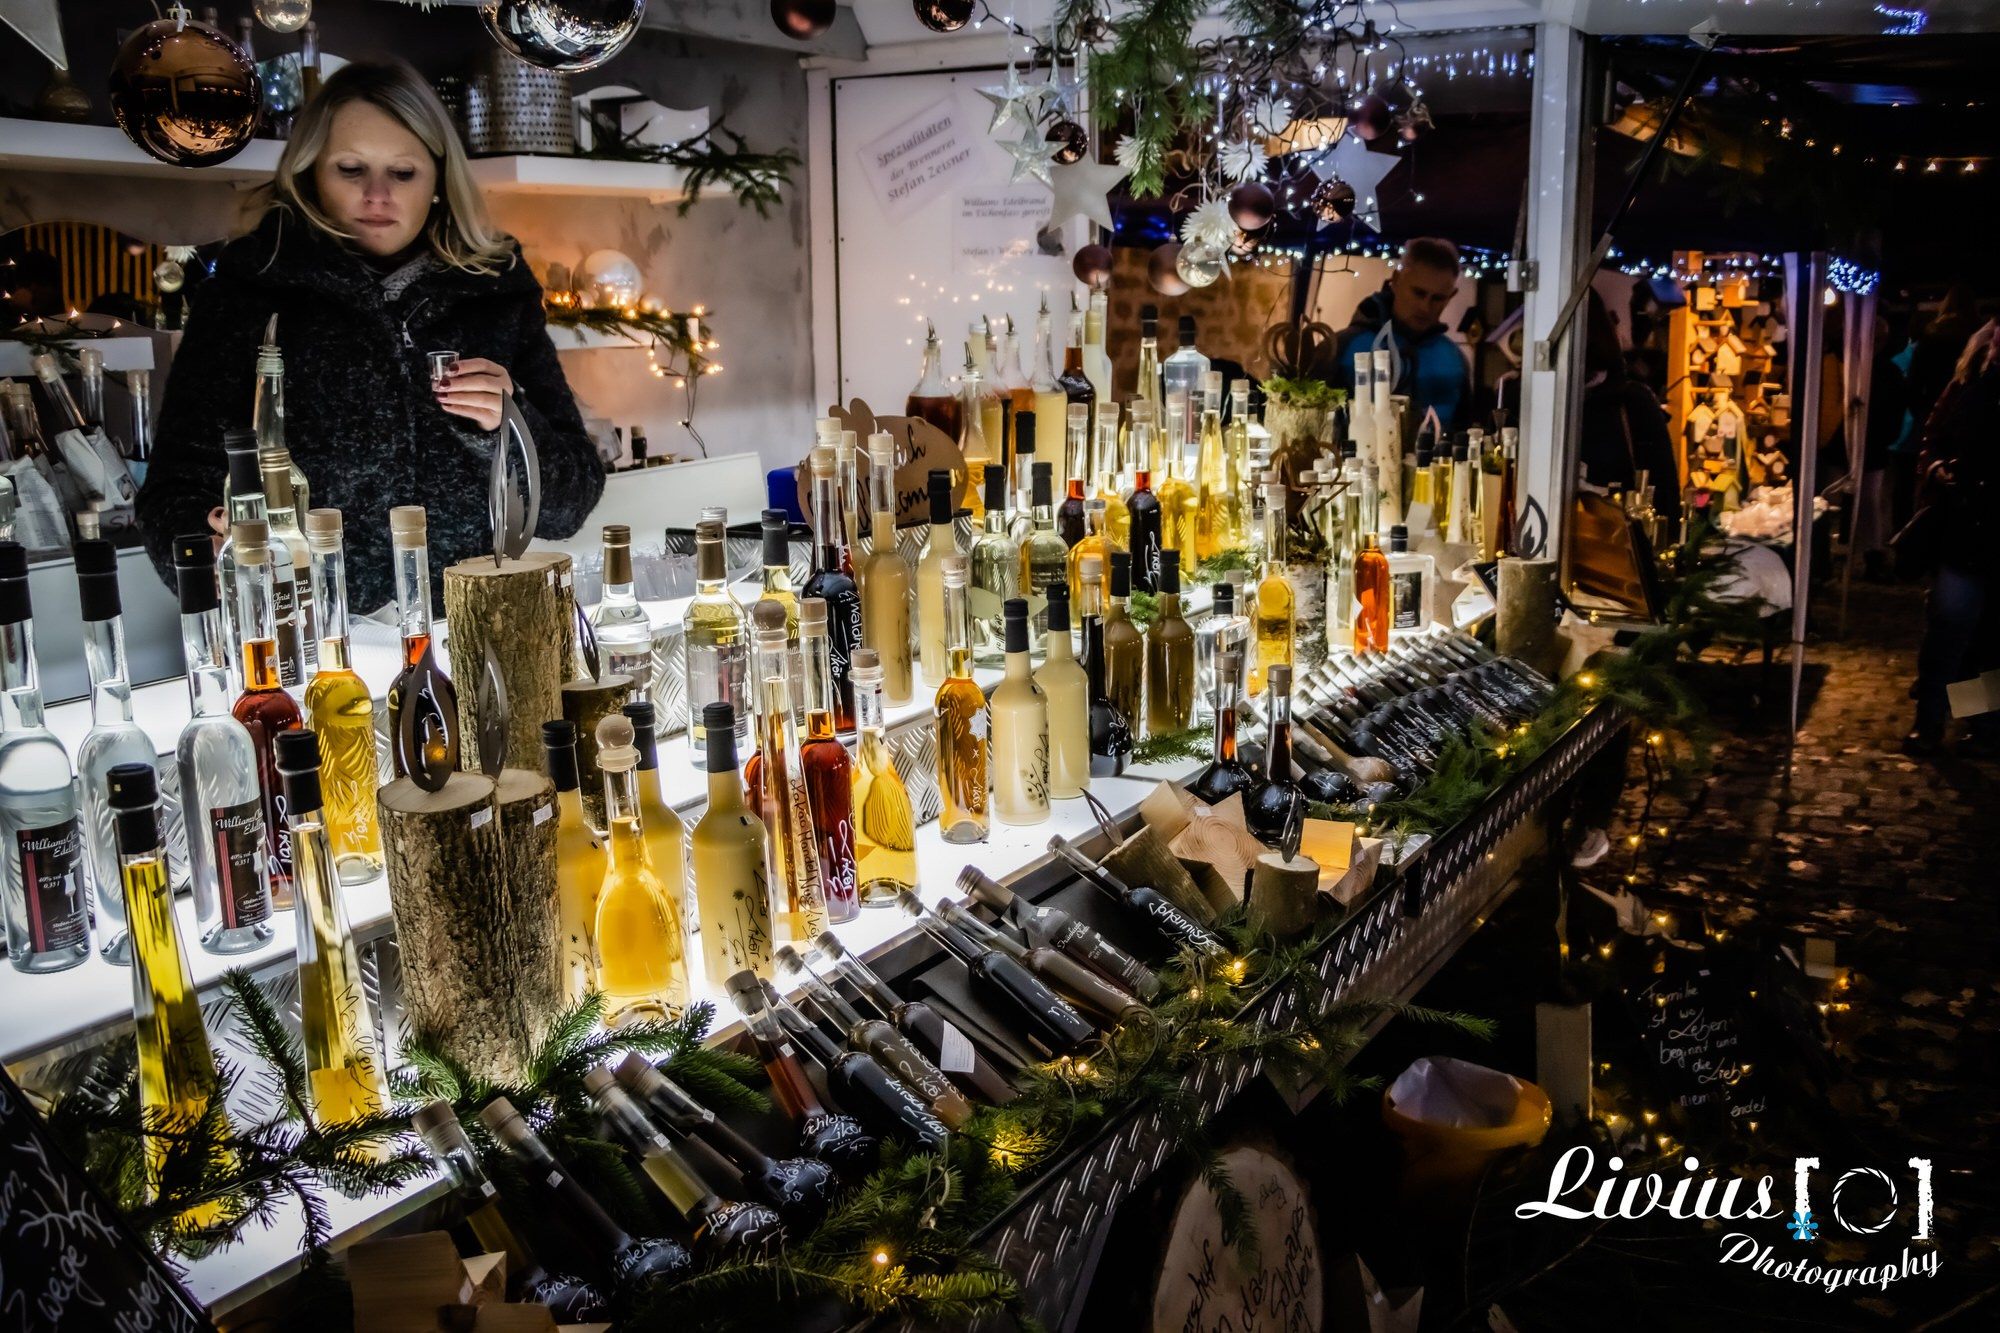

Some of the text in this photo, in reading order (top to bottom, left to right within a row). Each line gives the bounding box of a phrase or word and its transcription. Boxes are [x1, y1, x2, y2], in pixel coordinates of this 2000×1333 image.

[877, 116, 952, 169] Spezialitäten
[907, 138, 956, 171] Brennerei
[888, 172, 926, 202] Stefan
[22, 837, 66, 852] Williams
[1668, 1007, 1727, 1041] Leben
[1660, 1040, 1708, 1068] beginnt
